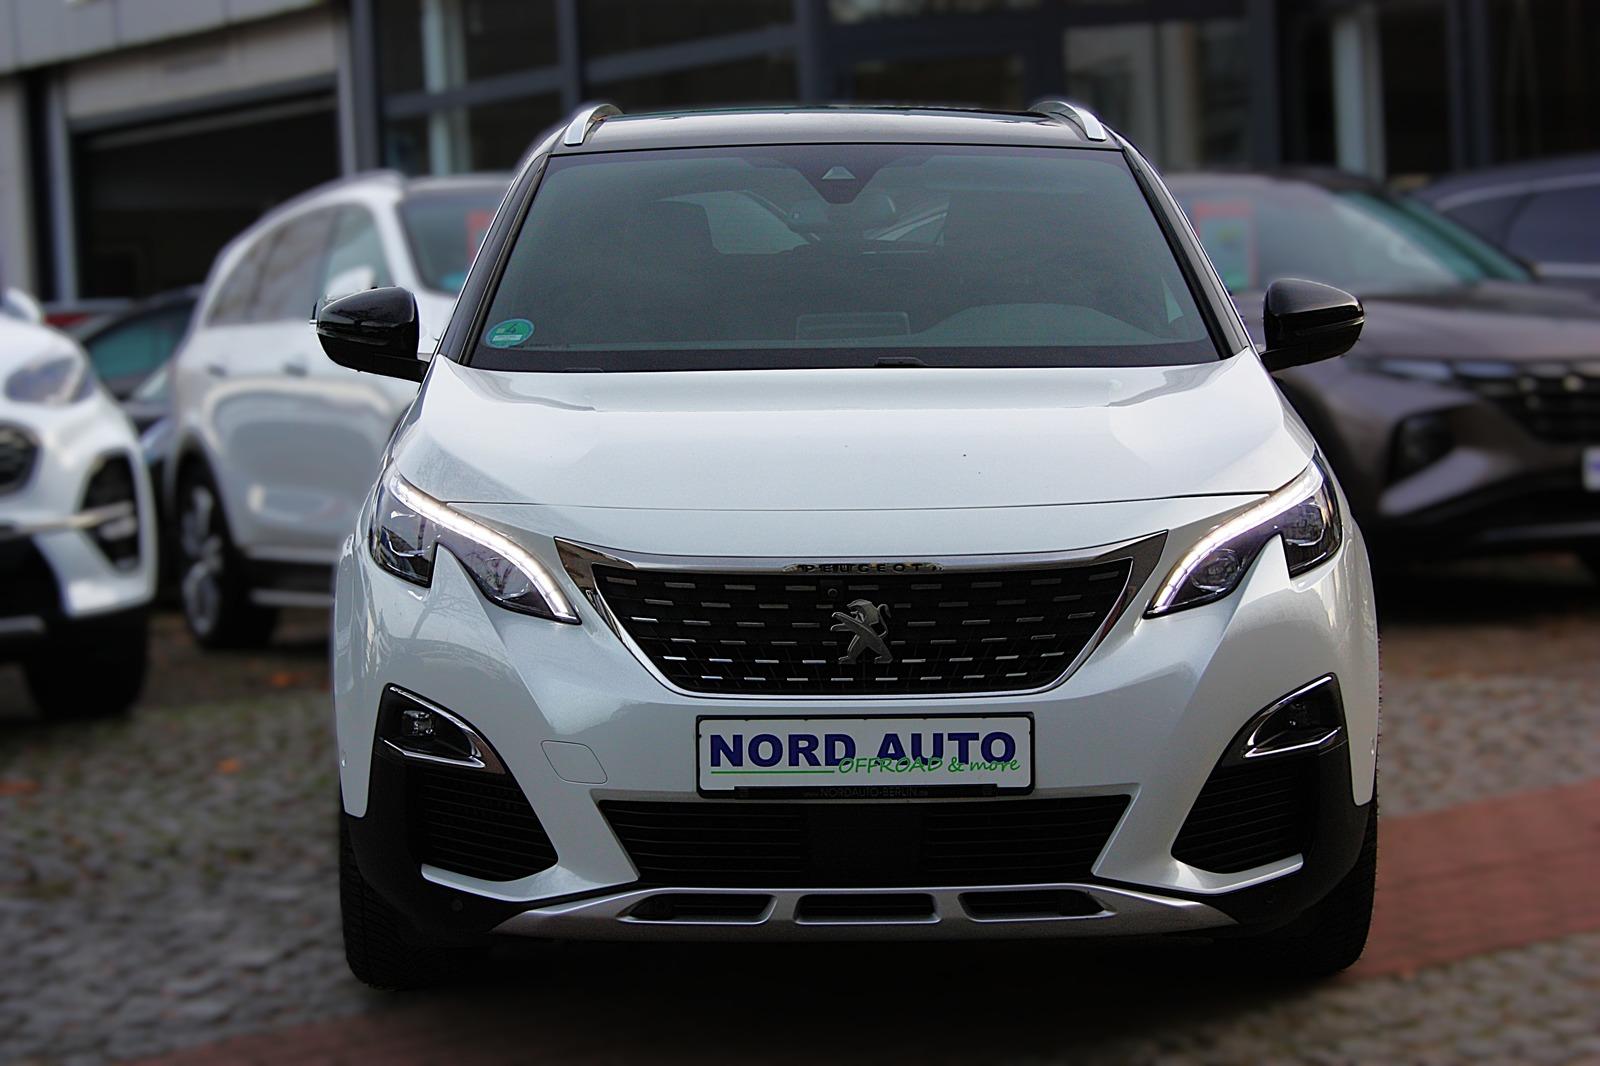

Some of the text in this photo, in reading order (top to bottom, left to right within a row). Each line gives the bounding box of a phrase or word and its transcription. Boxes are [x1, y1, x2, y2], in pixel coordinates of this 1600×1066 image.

[798, 563, 923, 573] PEUGEOT
[709, 731, 1016, 768] NORD AUTO
[837, 756, 1021, 774] OFFROAD & more
